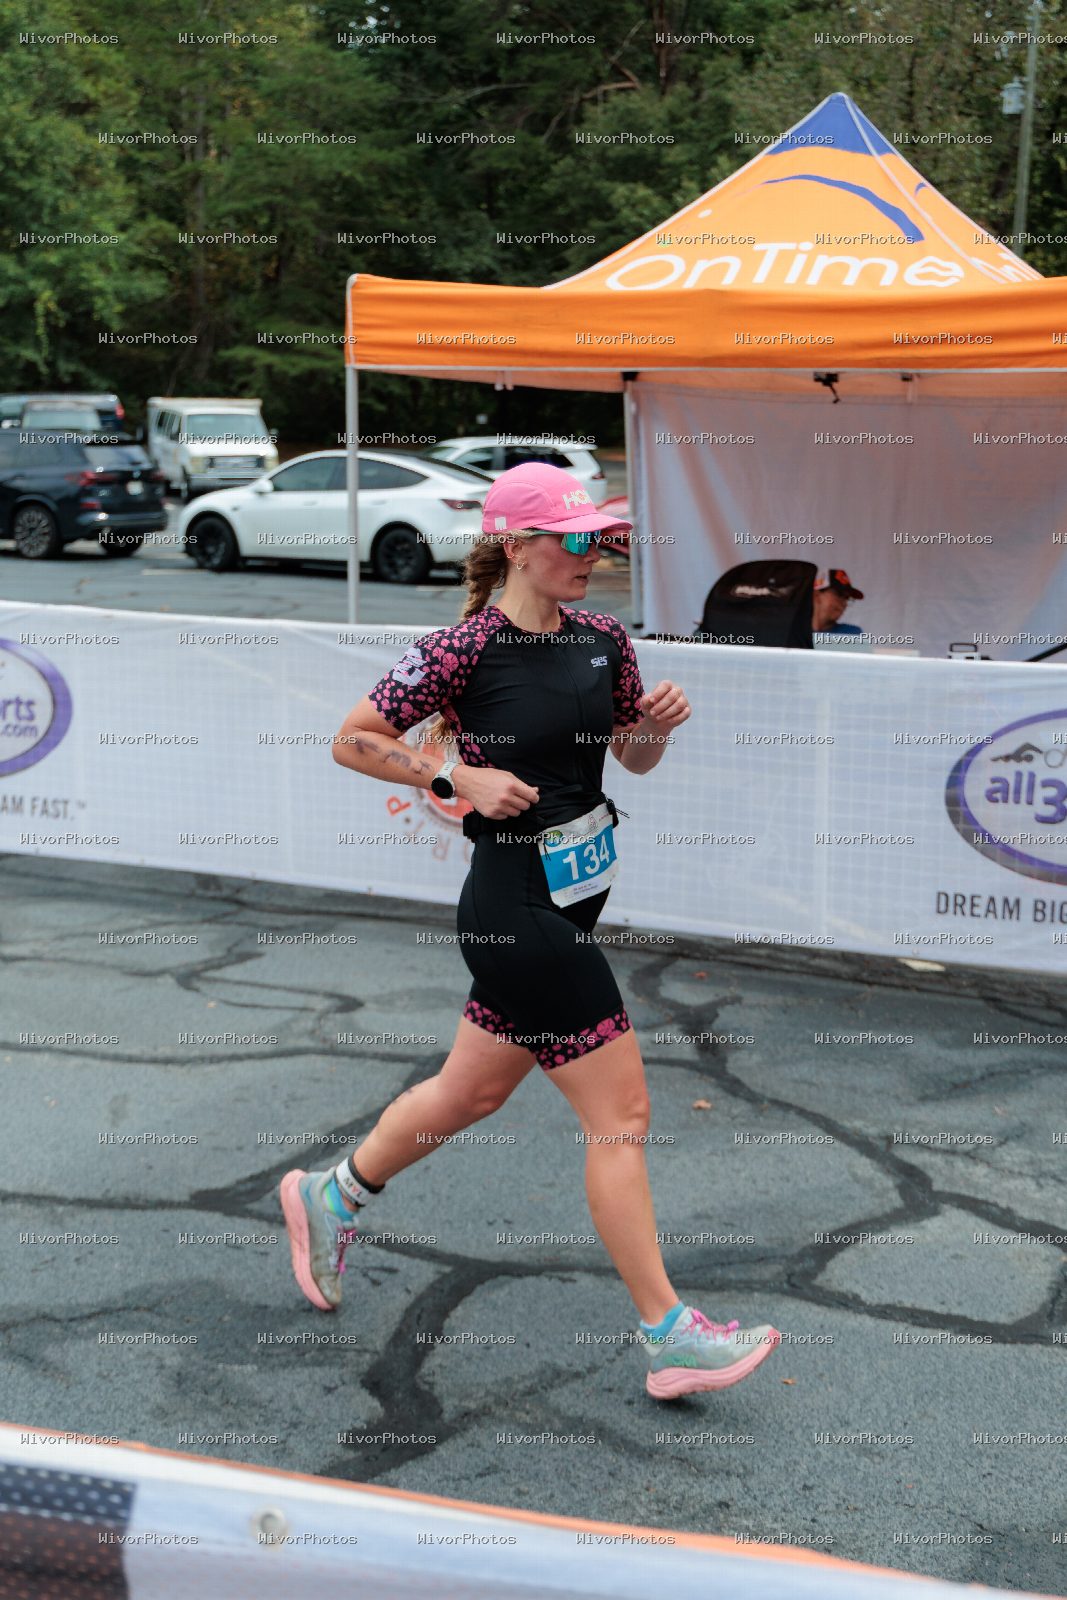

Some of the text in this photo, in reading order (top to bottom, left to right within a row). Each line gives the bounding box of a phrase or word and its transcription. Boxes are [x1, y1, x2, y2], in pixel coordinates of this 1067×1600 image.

[606, 242, 964, 290] OnTime
[562, 489, 593, 510] HO
[0, 697, 35, 721] rts
[562, 834, 610, 881] 134
[936, 891, 1020, 921] DREAM
